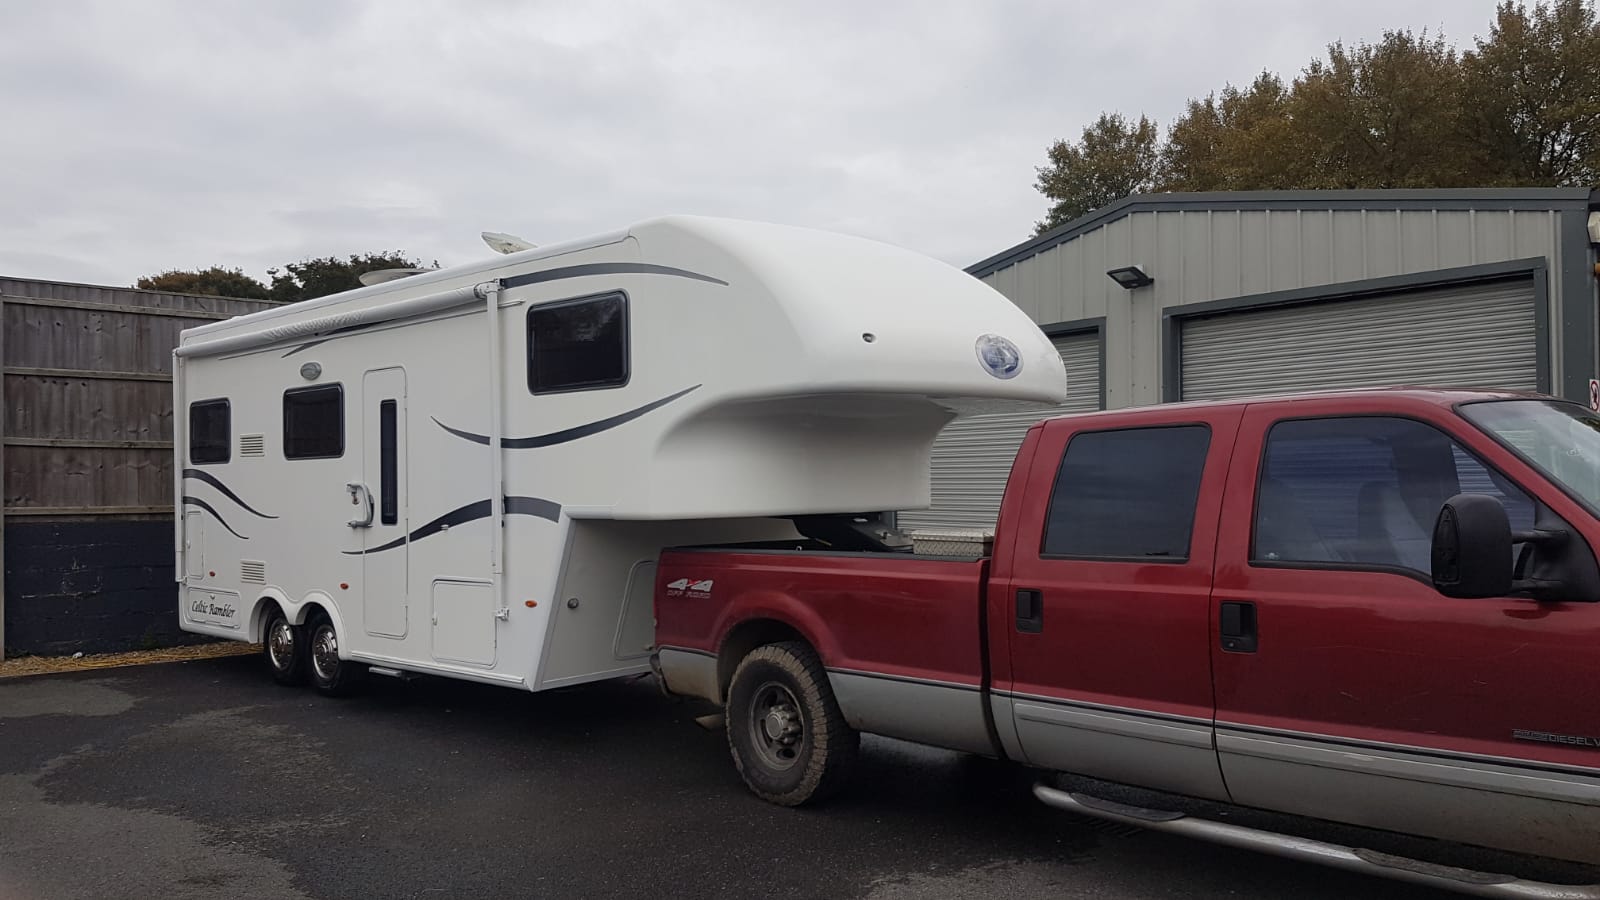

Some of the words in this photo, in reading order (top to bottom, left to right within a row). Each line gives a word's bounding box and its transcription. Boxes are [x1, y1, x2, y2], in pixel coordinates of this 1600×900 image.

[191, 600, 208, 613] Celtic
[209, 603, 236, 618] Rambler
[1549, 734, 1593, 746] DIESEL
